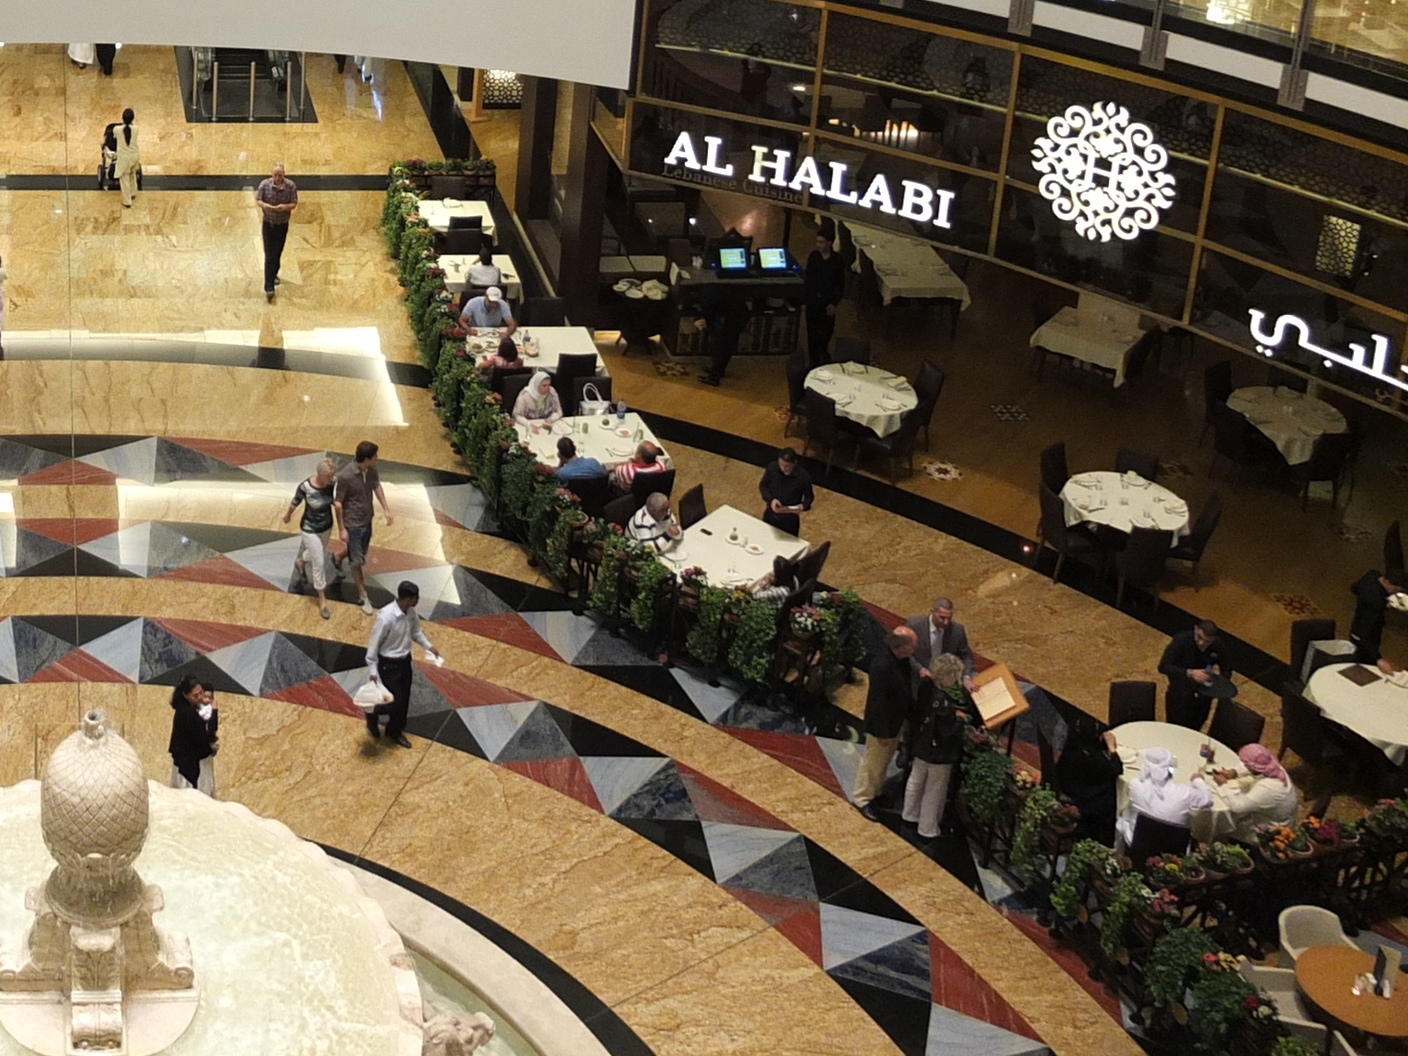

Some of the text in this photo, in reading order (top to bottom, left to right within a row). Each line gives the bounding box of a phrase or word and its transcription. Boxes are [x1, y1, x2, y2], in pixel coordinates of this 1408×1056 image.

[663, 130, 955, 229] AL HALABI
[1248, 308, 1408, 392] لبي
